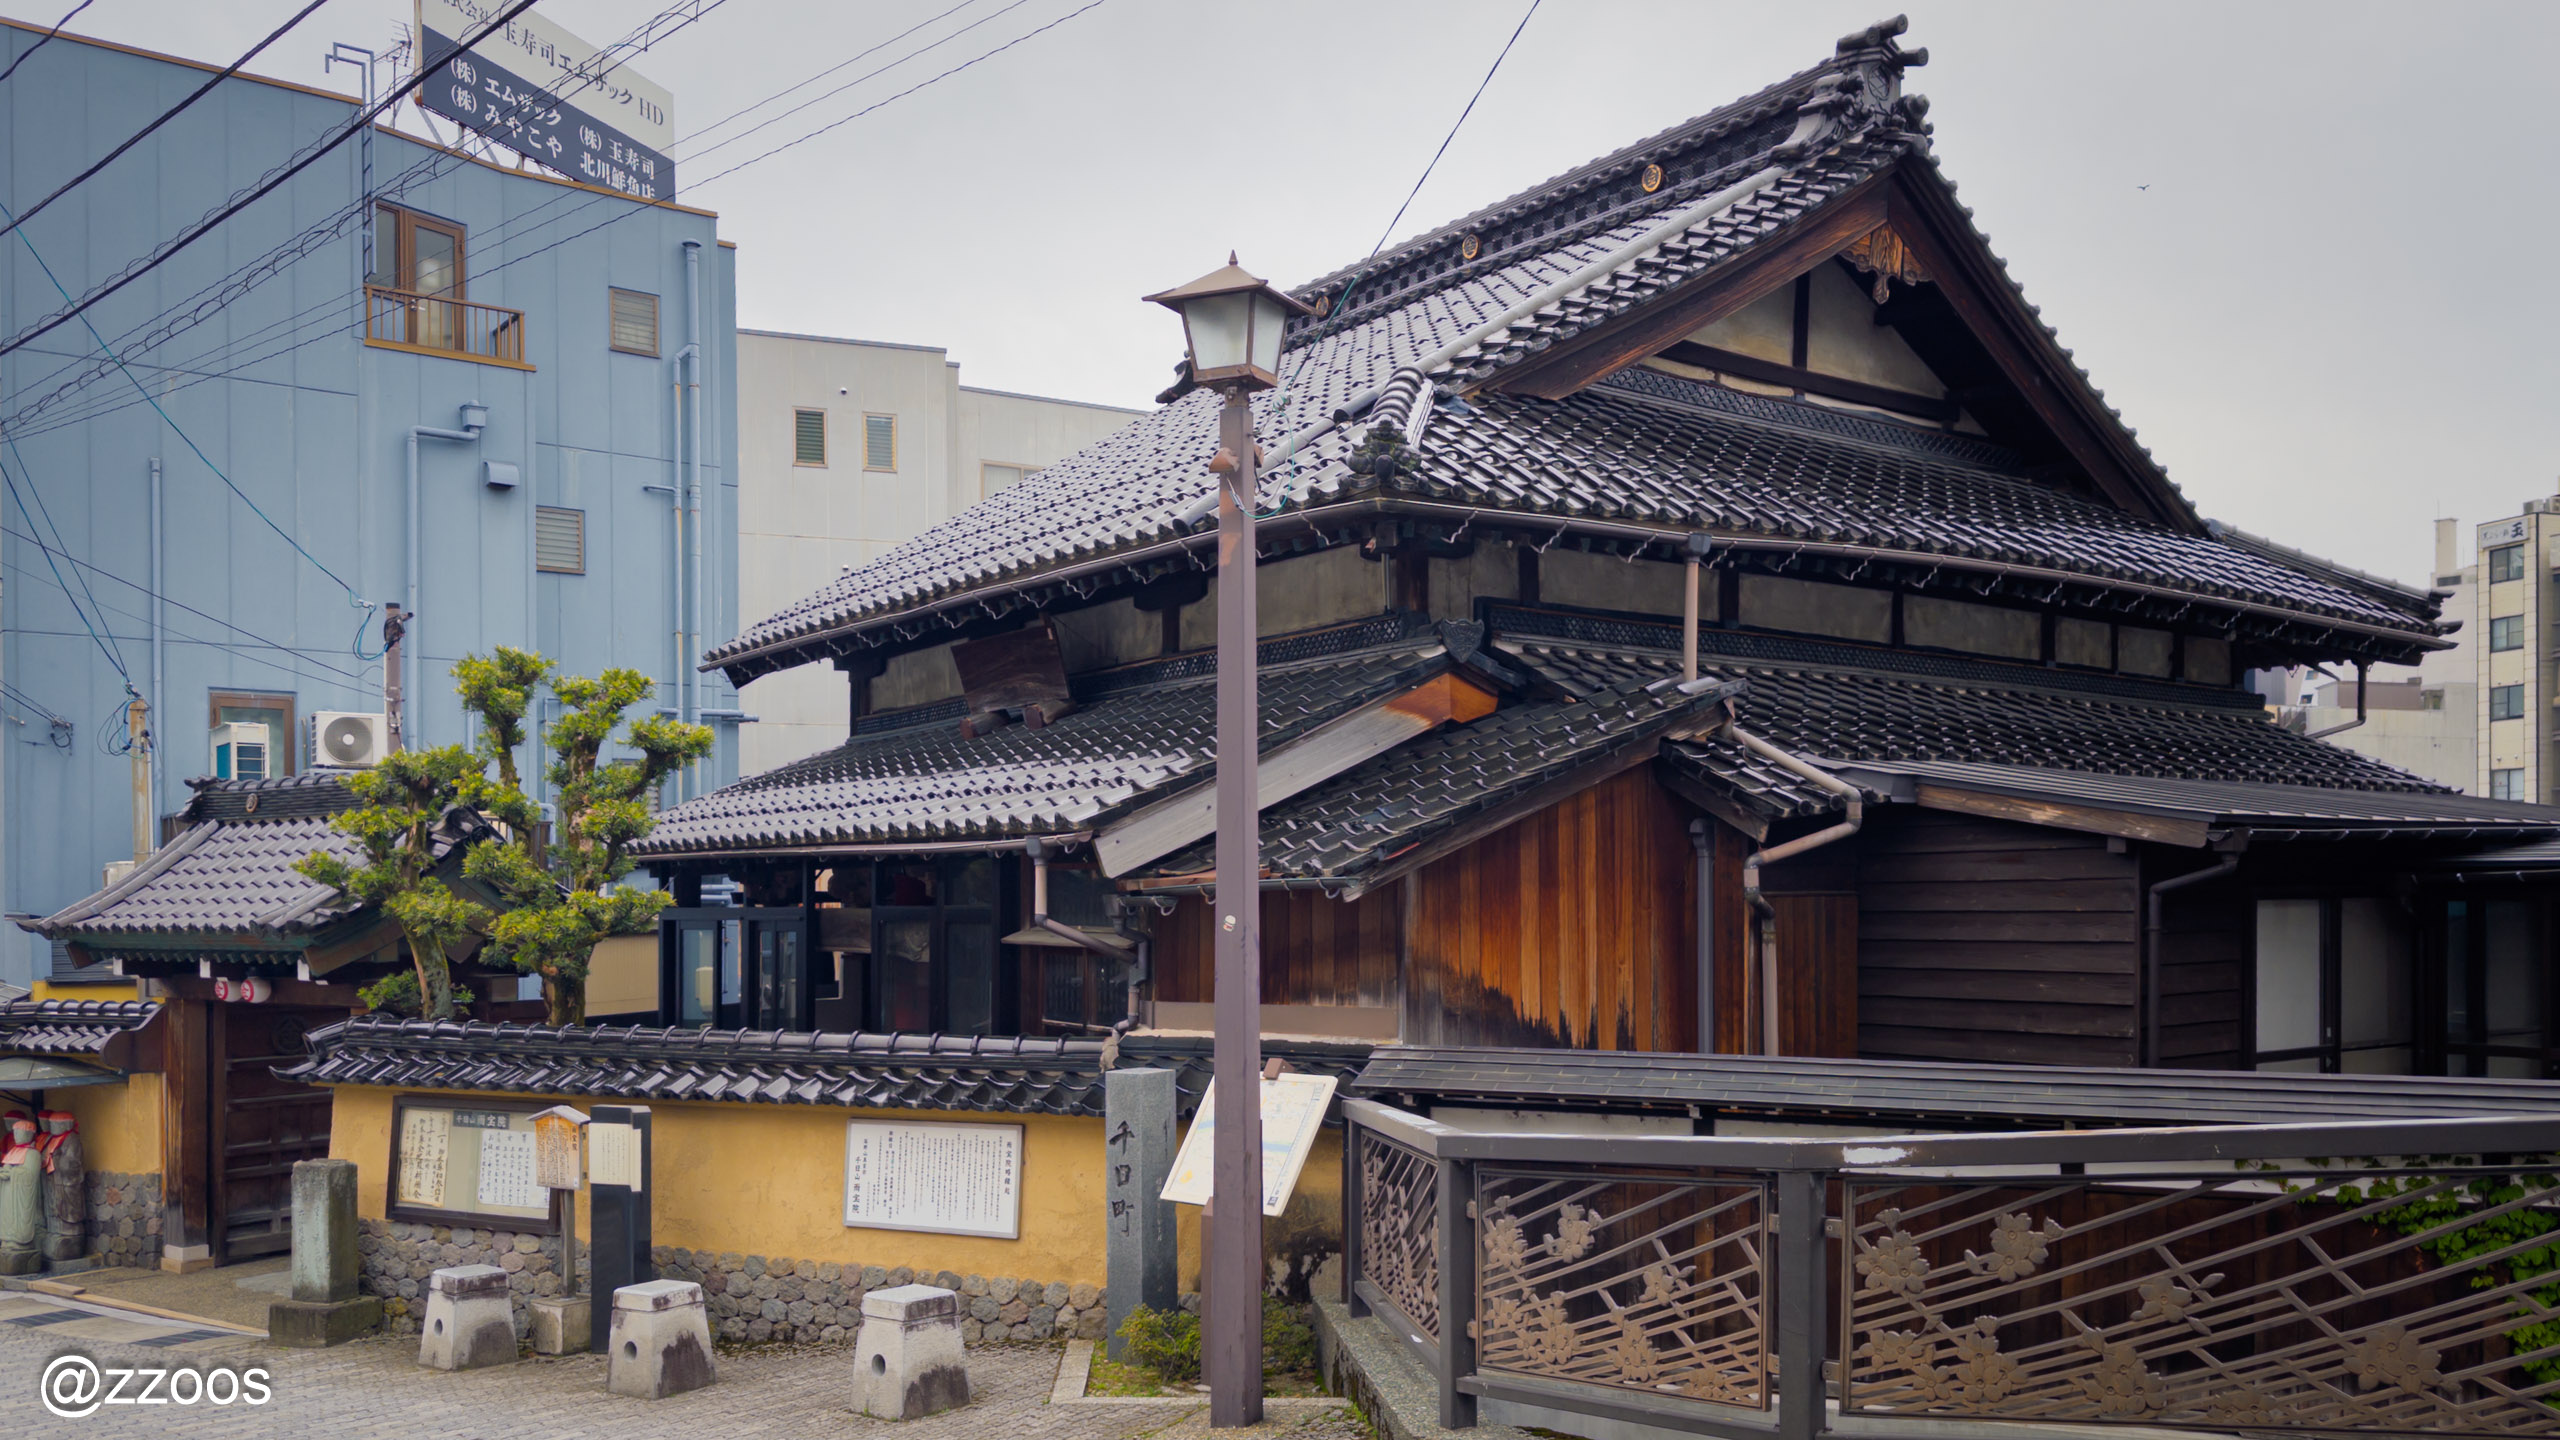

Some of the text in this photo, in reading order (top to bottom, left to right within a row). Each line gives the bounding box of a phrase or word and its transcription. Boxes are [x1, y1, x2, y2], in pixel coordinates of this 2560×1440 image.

[484, 103, 563, 159] みやこや
[608, 138, 655, 180] 玉寿司
